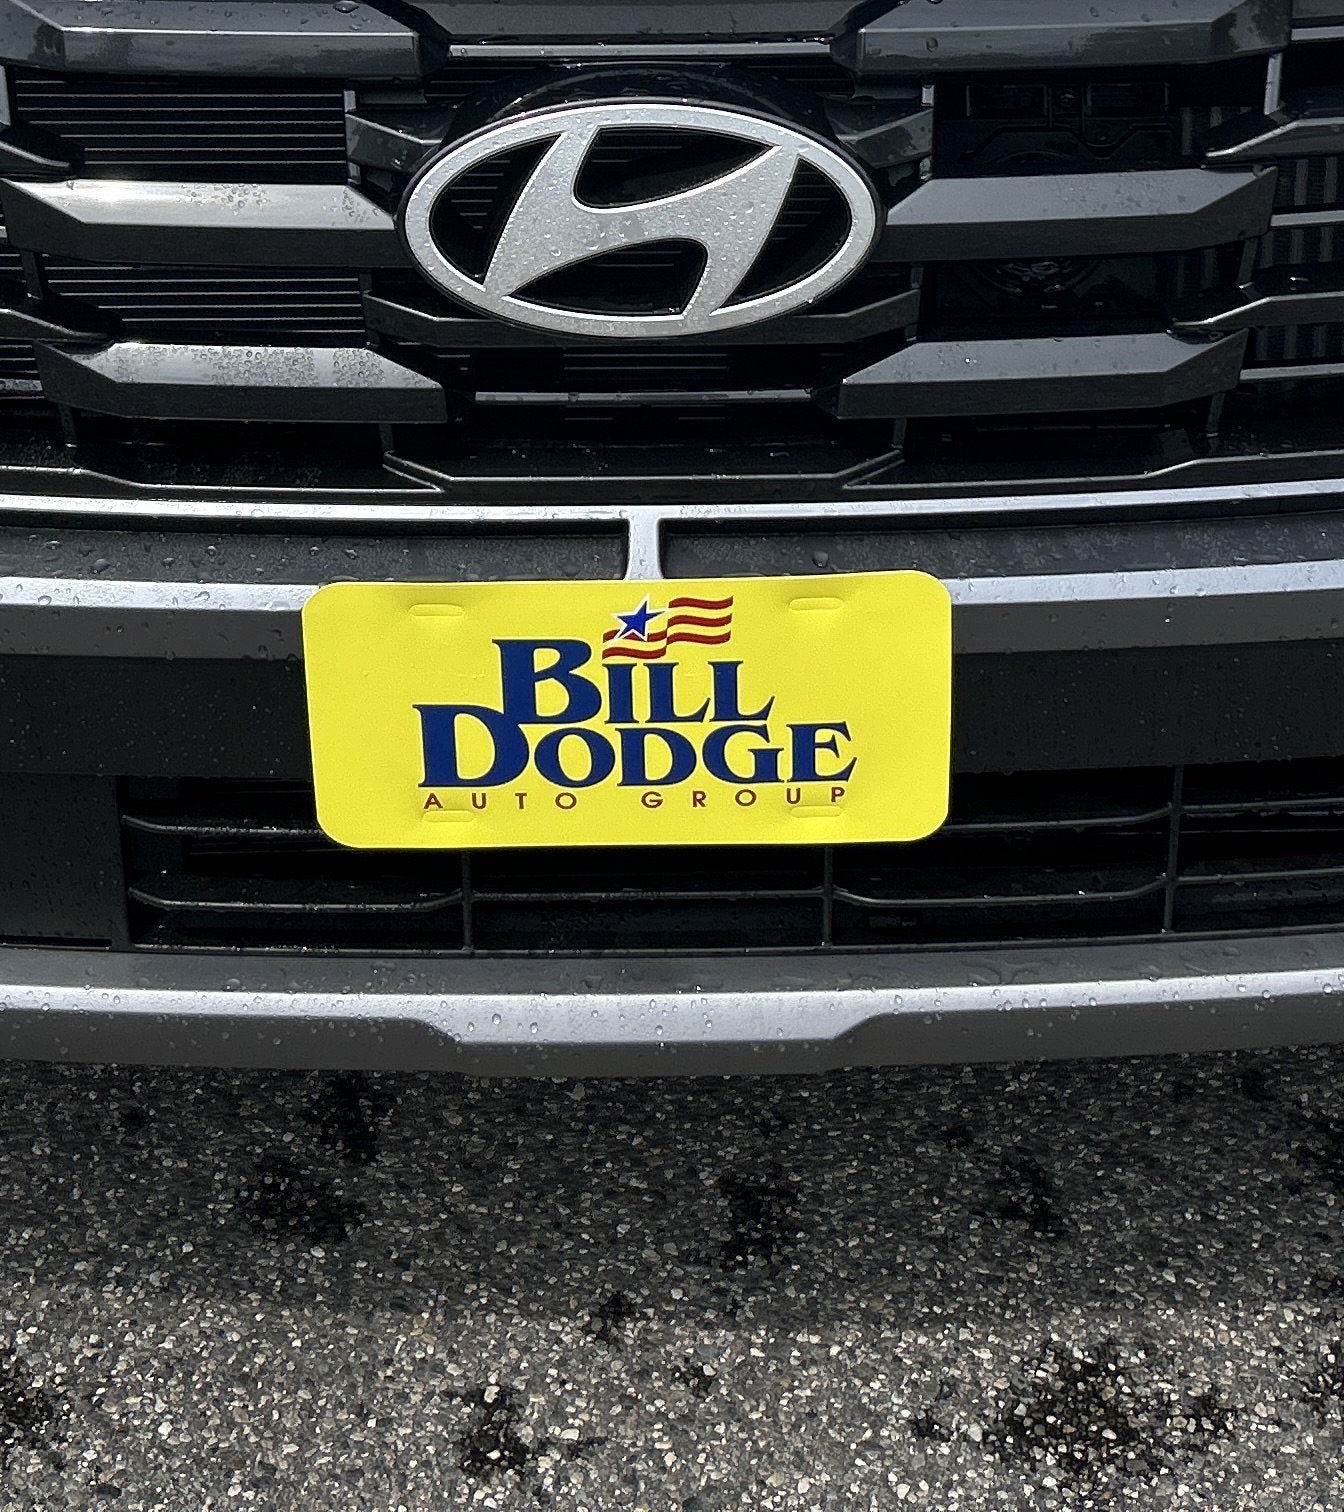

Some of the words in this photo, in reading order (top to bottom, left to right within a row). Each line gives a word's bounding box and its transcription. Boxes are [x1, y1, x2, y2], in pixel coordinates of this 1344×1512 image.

[491, 638, 775, 725] BILL
[412, 703, 857, 789] DODGE
[423, 792, 577, 810] AUTO
[640, 786, 846, 809] GROUP
